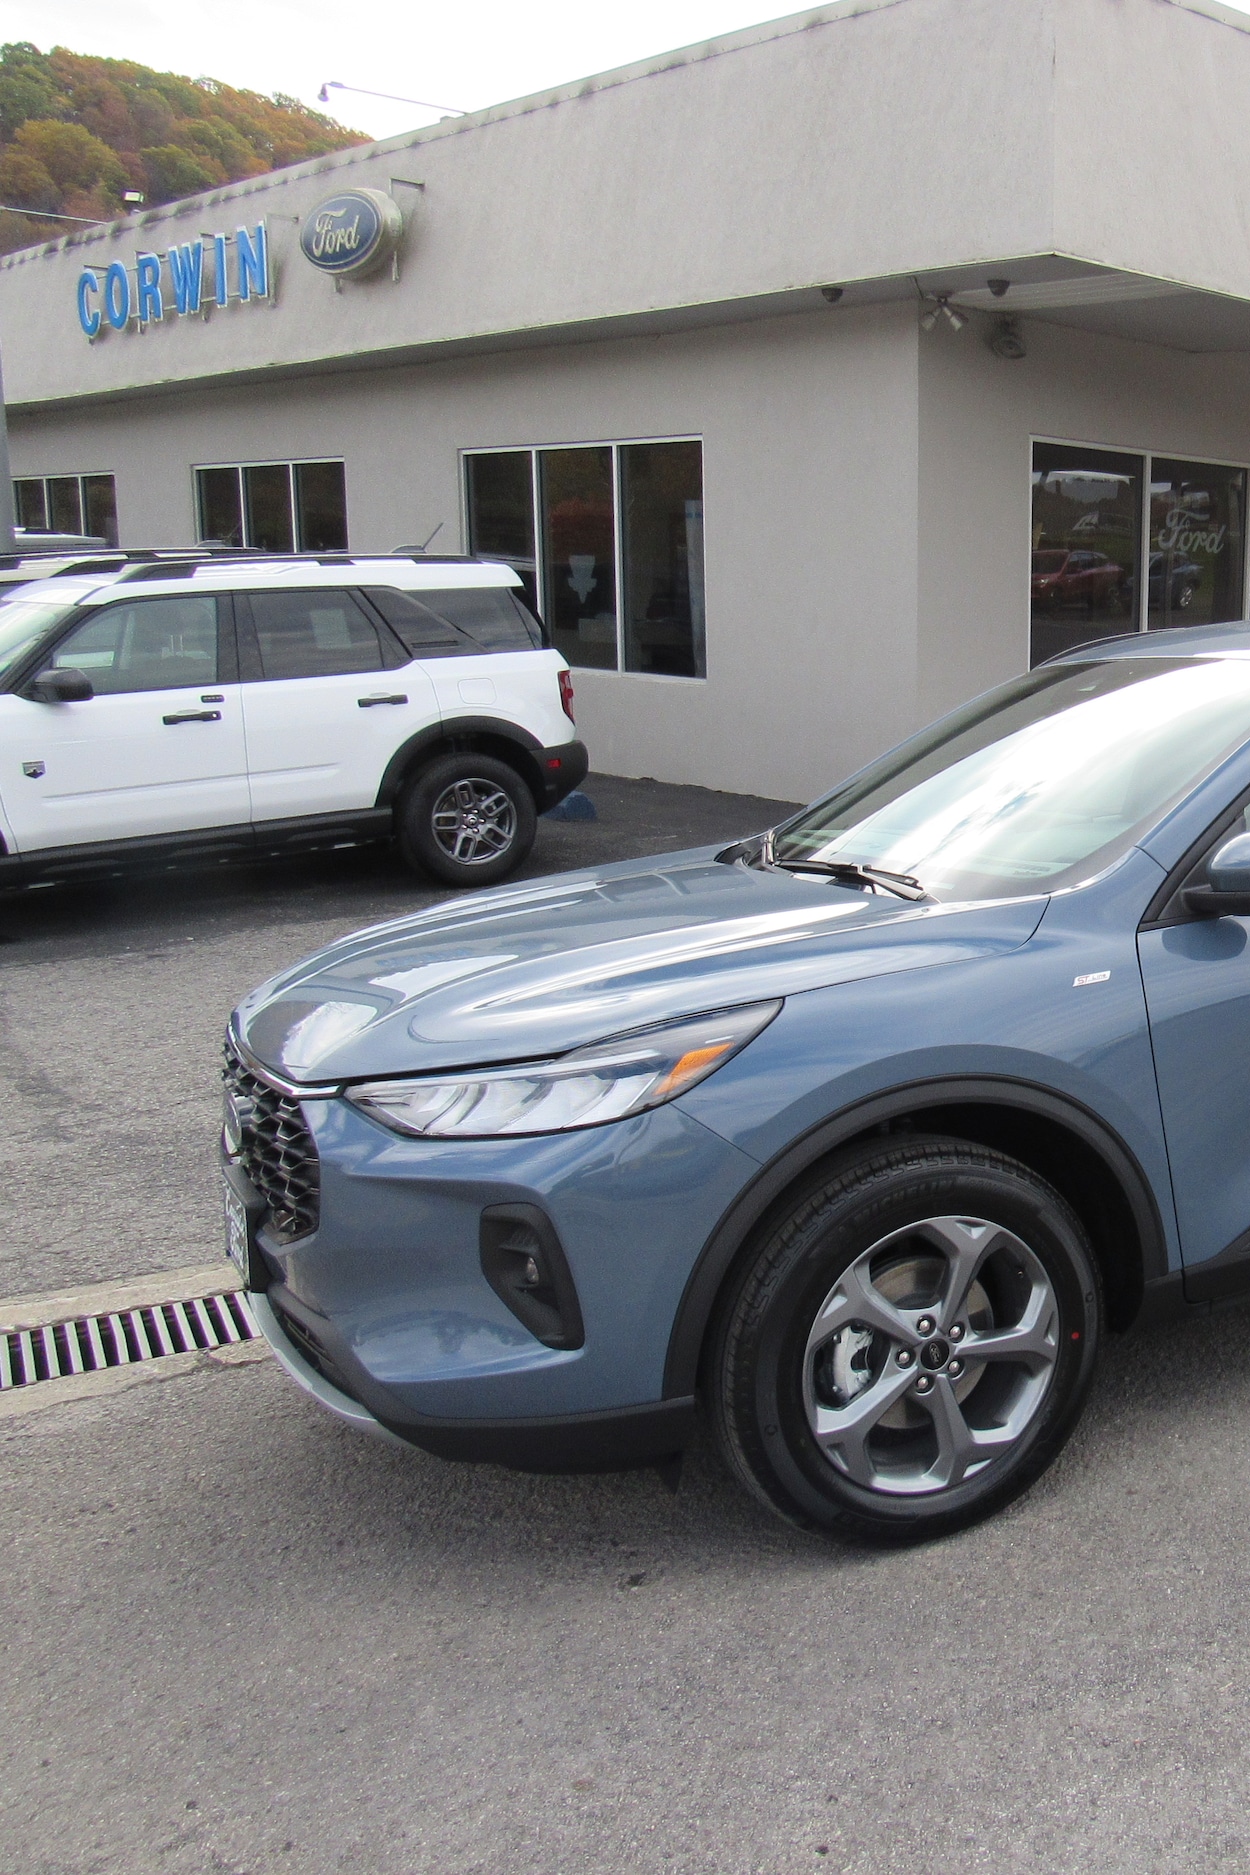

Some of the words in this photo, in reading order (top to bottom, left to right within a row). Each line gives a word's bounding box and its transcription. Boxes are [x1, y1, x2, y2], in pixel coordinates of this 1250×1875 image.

[312, 207, 361, 257] Ford
[77, 220, 269, 338] CORWIN
[1157, 508, 1227, 554] Ford
